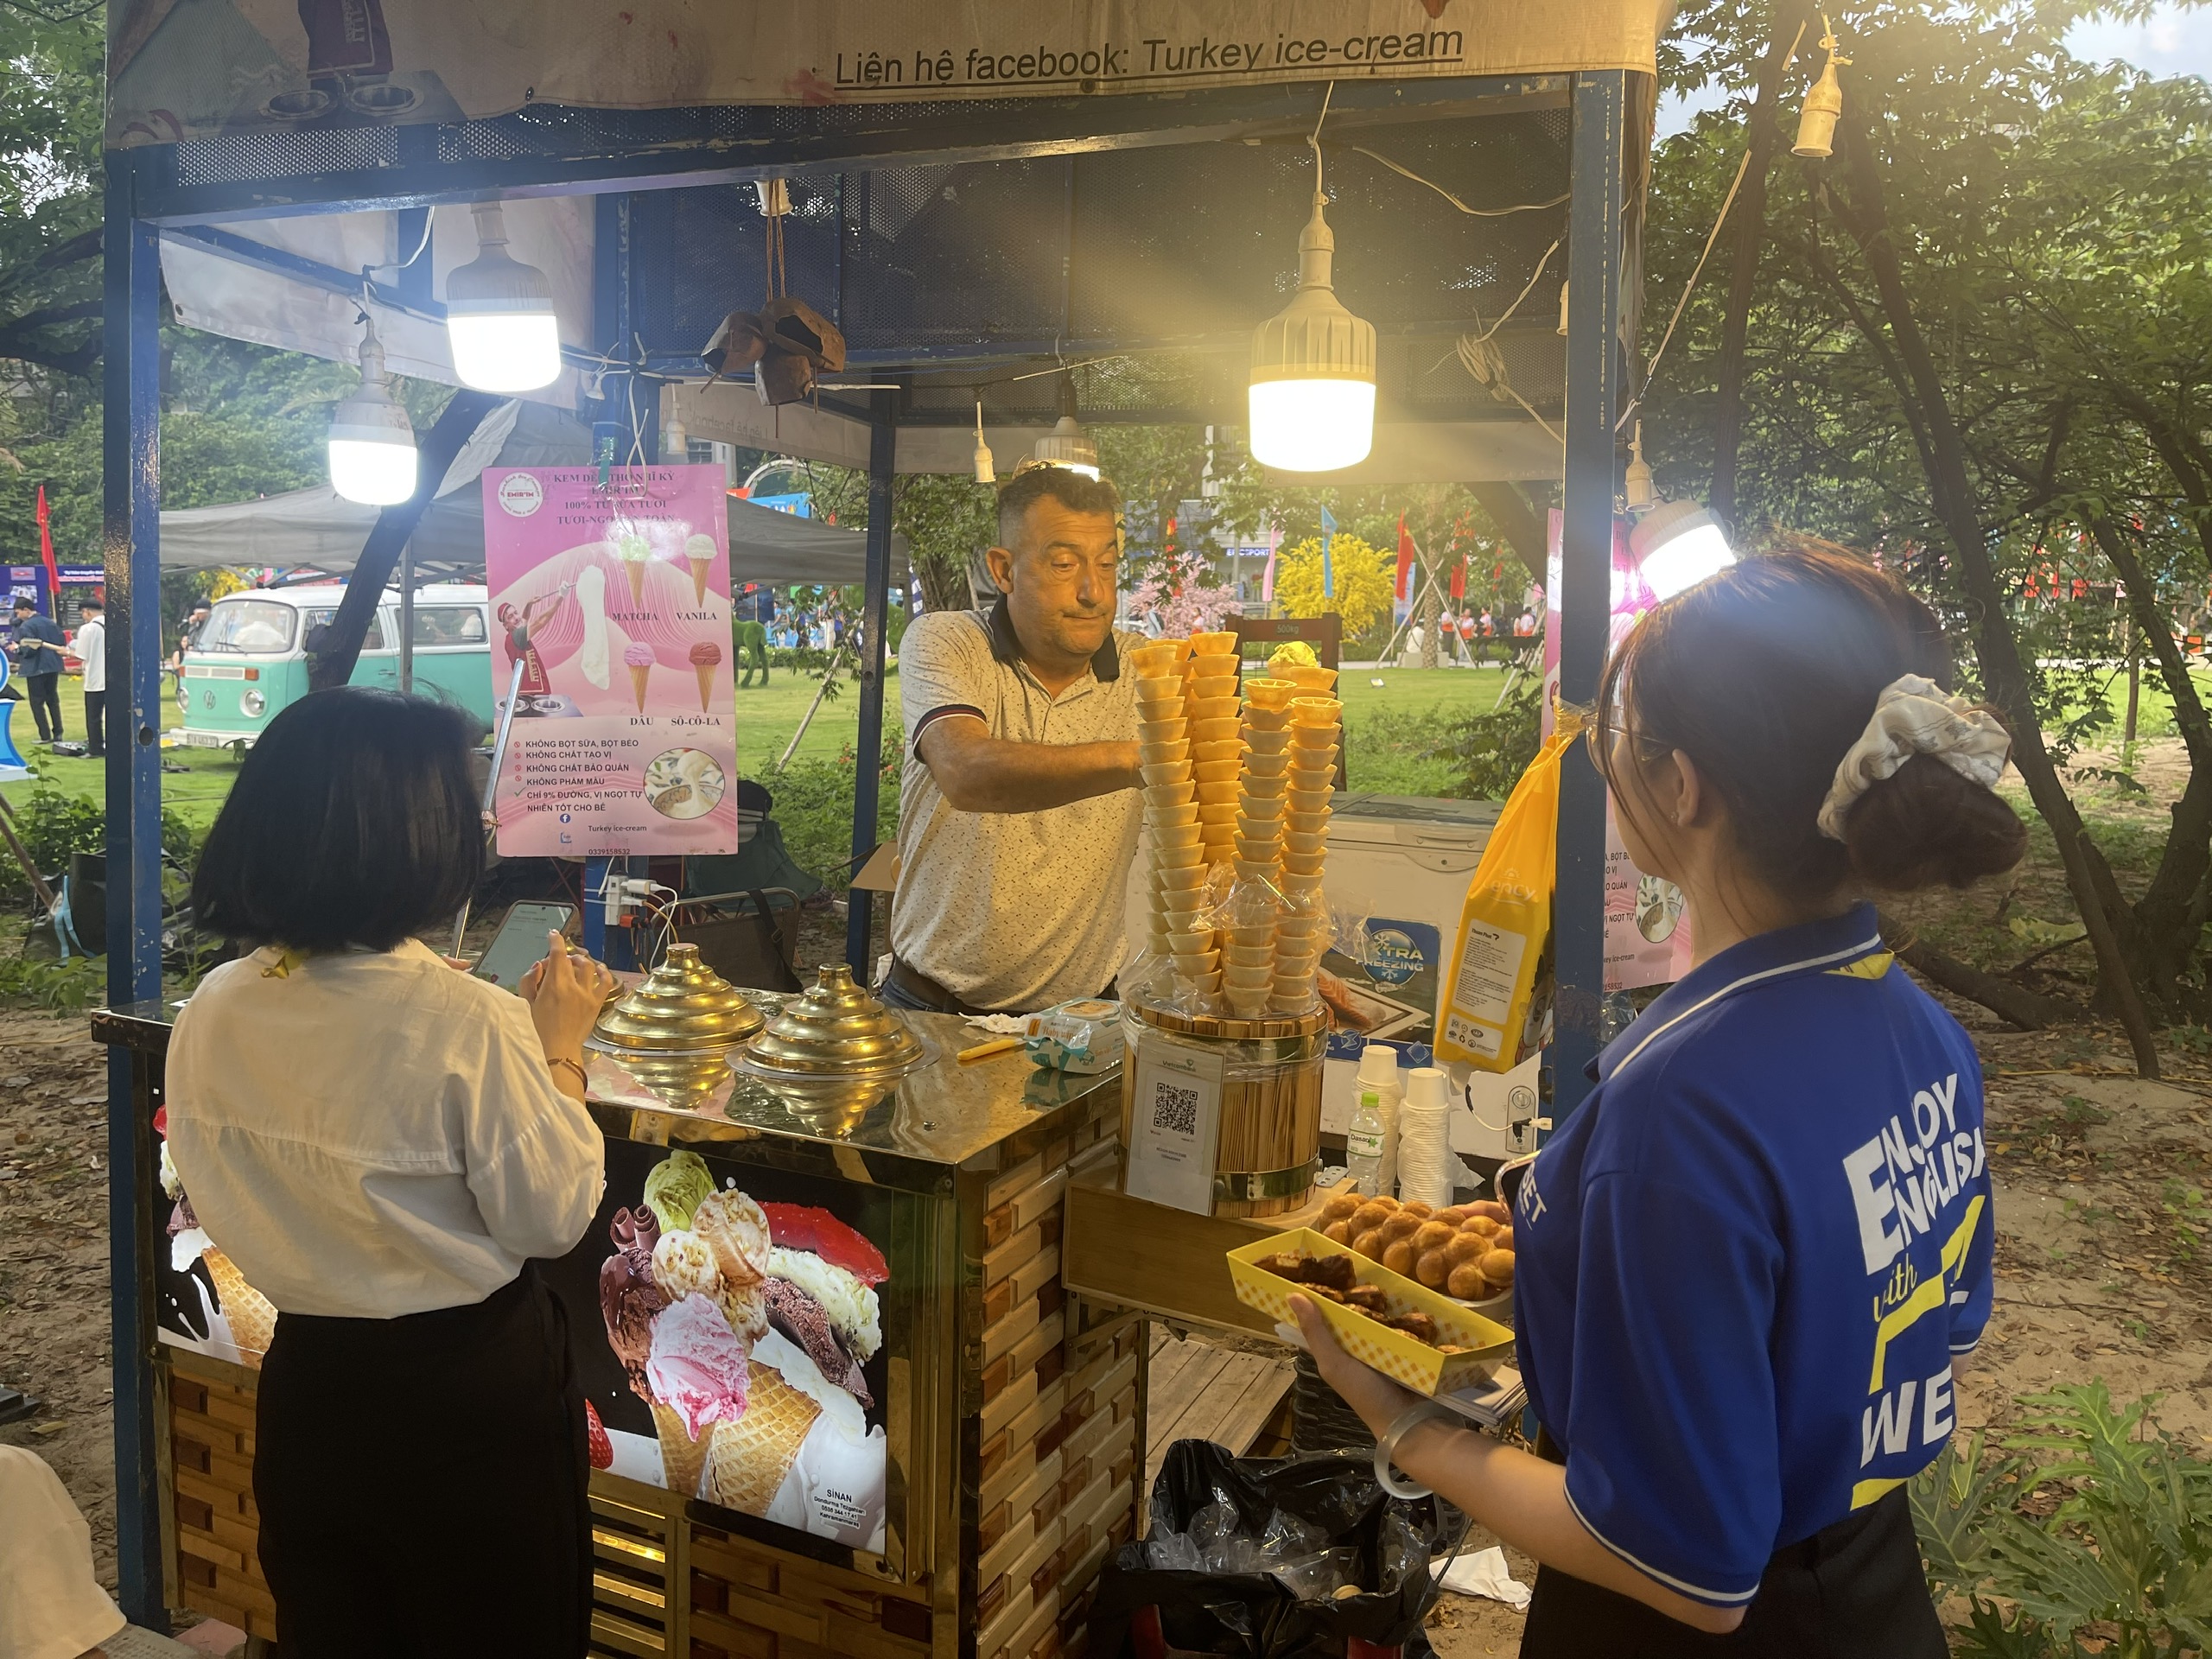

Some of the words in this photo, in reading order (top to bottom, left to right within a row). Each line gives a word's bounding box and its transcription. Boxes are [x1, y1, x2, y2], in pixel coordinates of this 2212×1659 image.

[836, 52, 902, 84] Liên
[915, 49, 955, 85] hệ
[966, 43, 1128, 79] facebook:
[1142, 36, 1263, 73] Turkey
[1275, 30, 1463, 64] ice-cream
[564, 501, 592, 510] 100%
[639, 499, 667, 508] TƯƠI
[613, 612, 658, 621] MATCHA
[677, 612, 717, 621] VANILA
[630, 715, 654, 726] DÂU
[671, 715, 721, 727] SÔ-CÔ-LA
[525, 740, 556, 748] KHÔNG
[558, 739, 576, 749] BỘT
[578, 739, 600, 748] SỮA,
[601, 739, 619, 749] BỘT
[525, 750, 556, 759] KHÔNG
[584, 751, 601, 760] TẠO
[603, 751, 612, 760] VỊ
[526, 764, 557, 772] KHÔNG
[526, 777, 557, 785] KHÔNG
[594, 791, 602, 800] VỊ
[605, 791, 629, 800] NGỌT
[527, 804, 553, 812] NHIÊN
[594, 803, 606, 811] BÉ
[1376, 945, 1424, 961] XTRA
[1355, 958, 1424, 972] FREEZING
